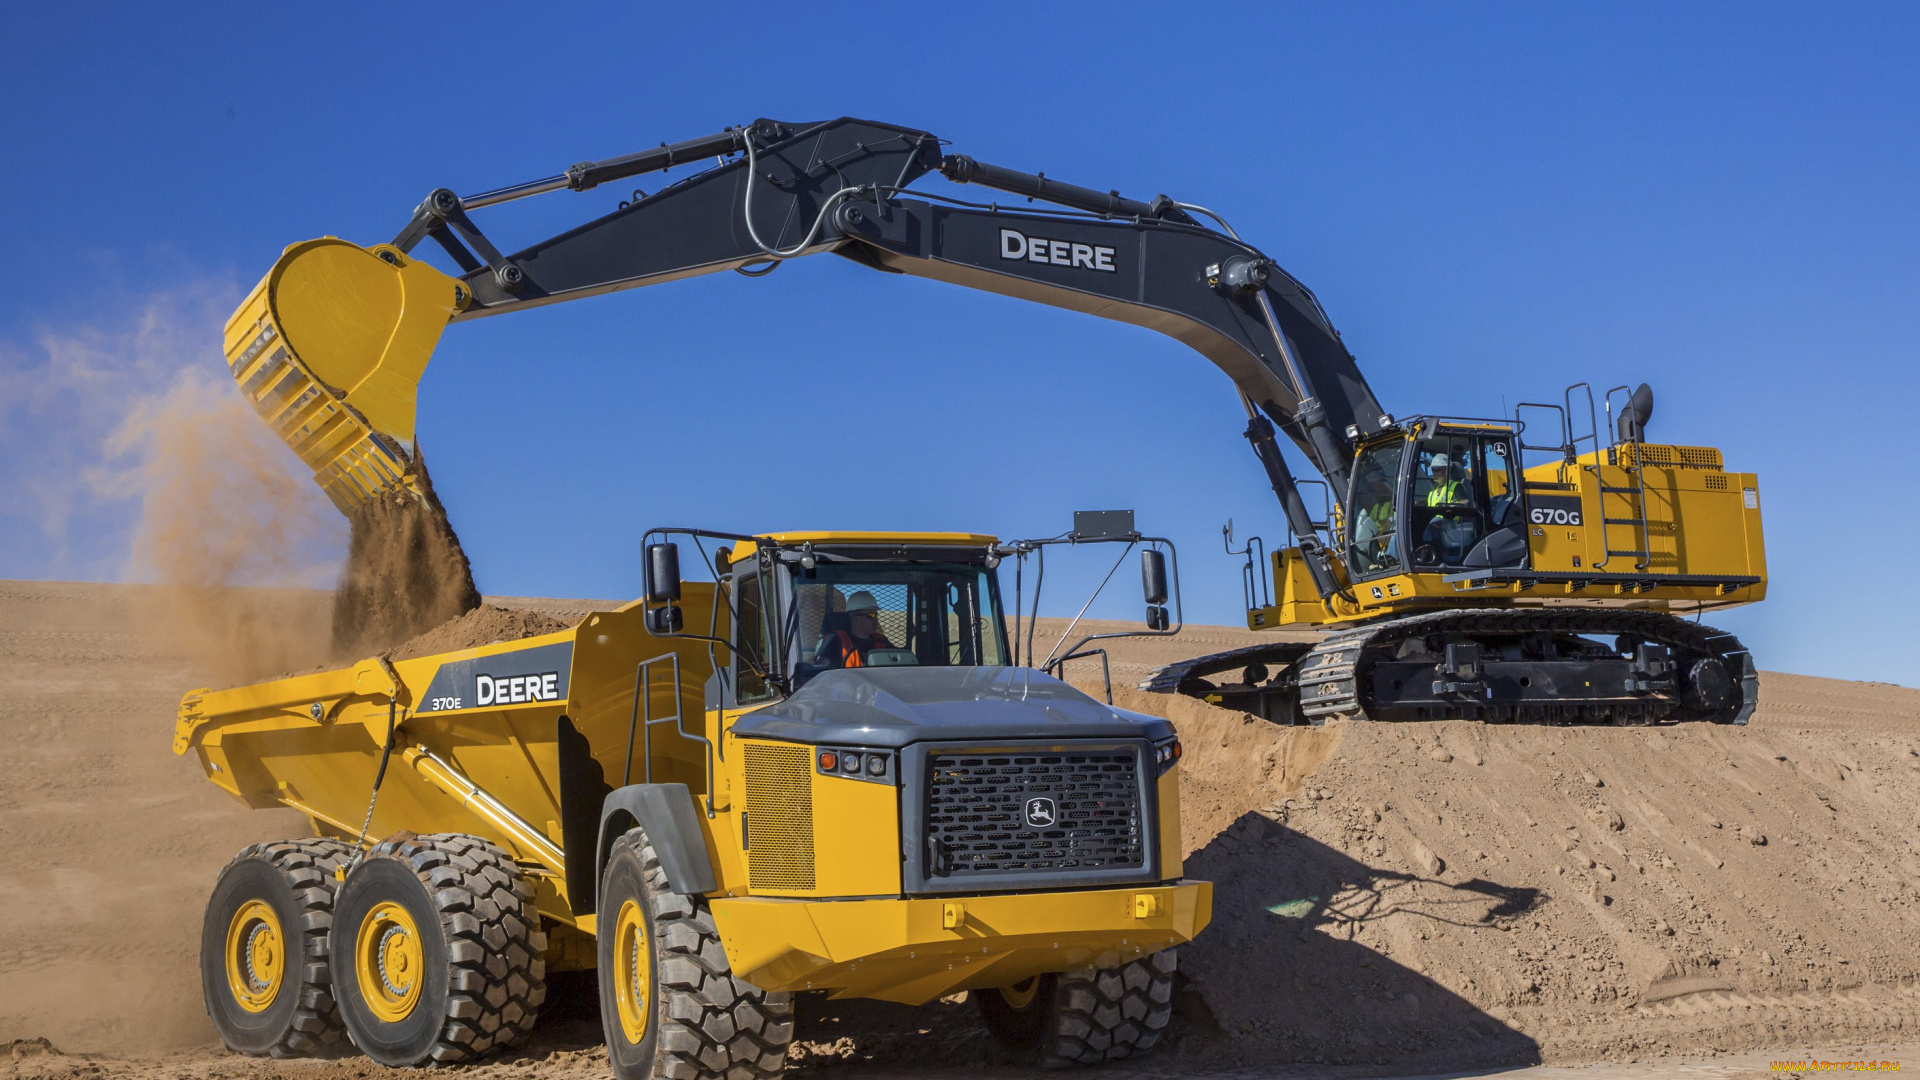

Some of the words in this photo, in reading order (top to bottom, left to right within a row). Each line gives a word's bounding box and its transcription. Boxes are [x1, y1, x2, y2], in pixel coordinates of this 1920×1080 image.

[1000, 228, 1116, 272] DEERE
[1530, 508, 1580, 525] 670G
[1532, 528, 1543, 536] LC
[476, 673, 558, 706] DEERE
[432, 697, 461, 711] 370E
